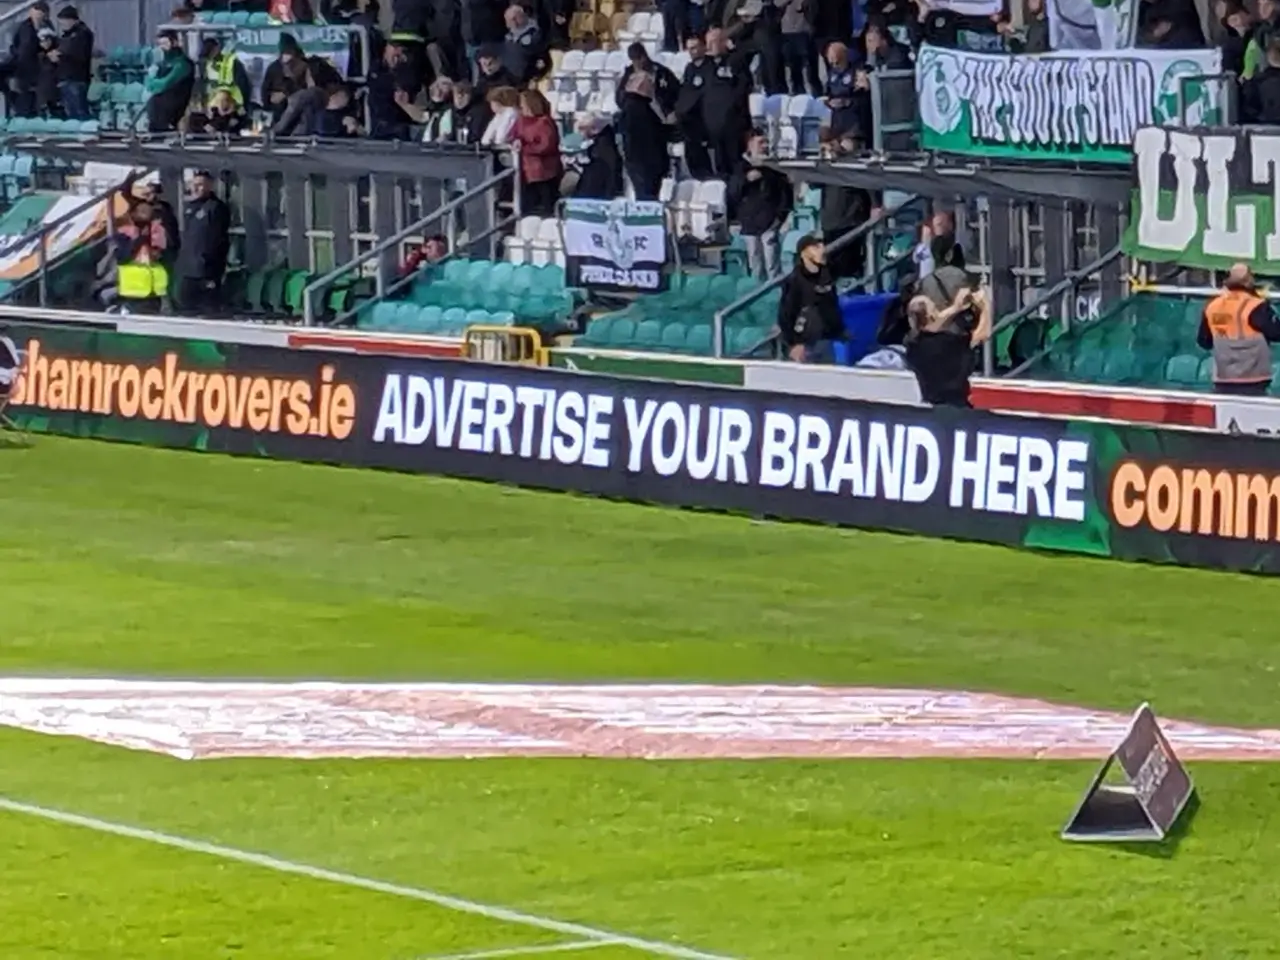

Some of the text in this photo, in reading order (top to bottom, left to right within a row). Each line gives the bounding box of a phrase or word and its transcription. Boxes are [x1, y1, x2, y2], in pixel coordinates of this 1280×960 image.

[373, 373, 614, 467] ADVERTISE
[623, 396, 752, 484] YOUR
[759, 411, 941, 503] BRAND
[949, 430, 1089, 521] HERE
